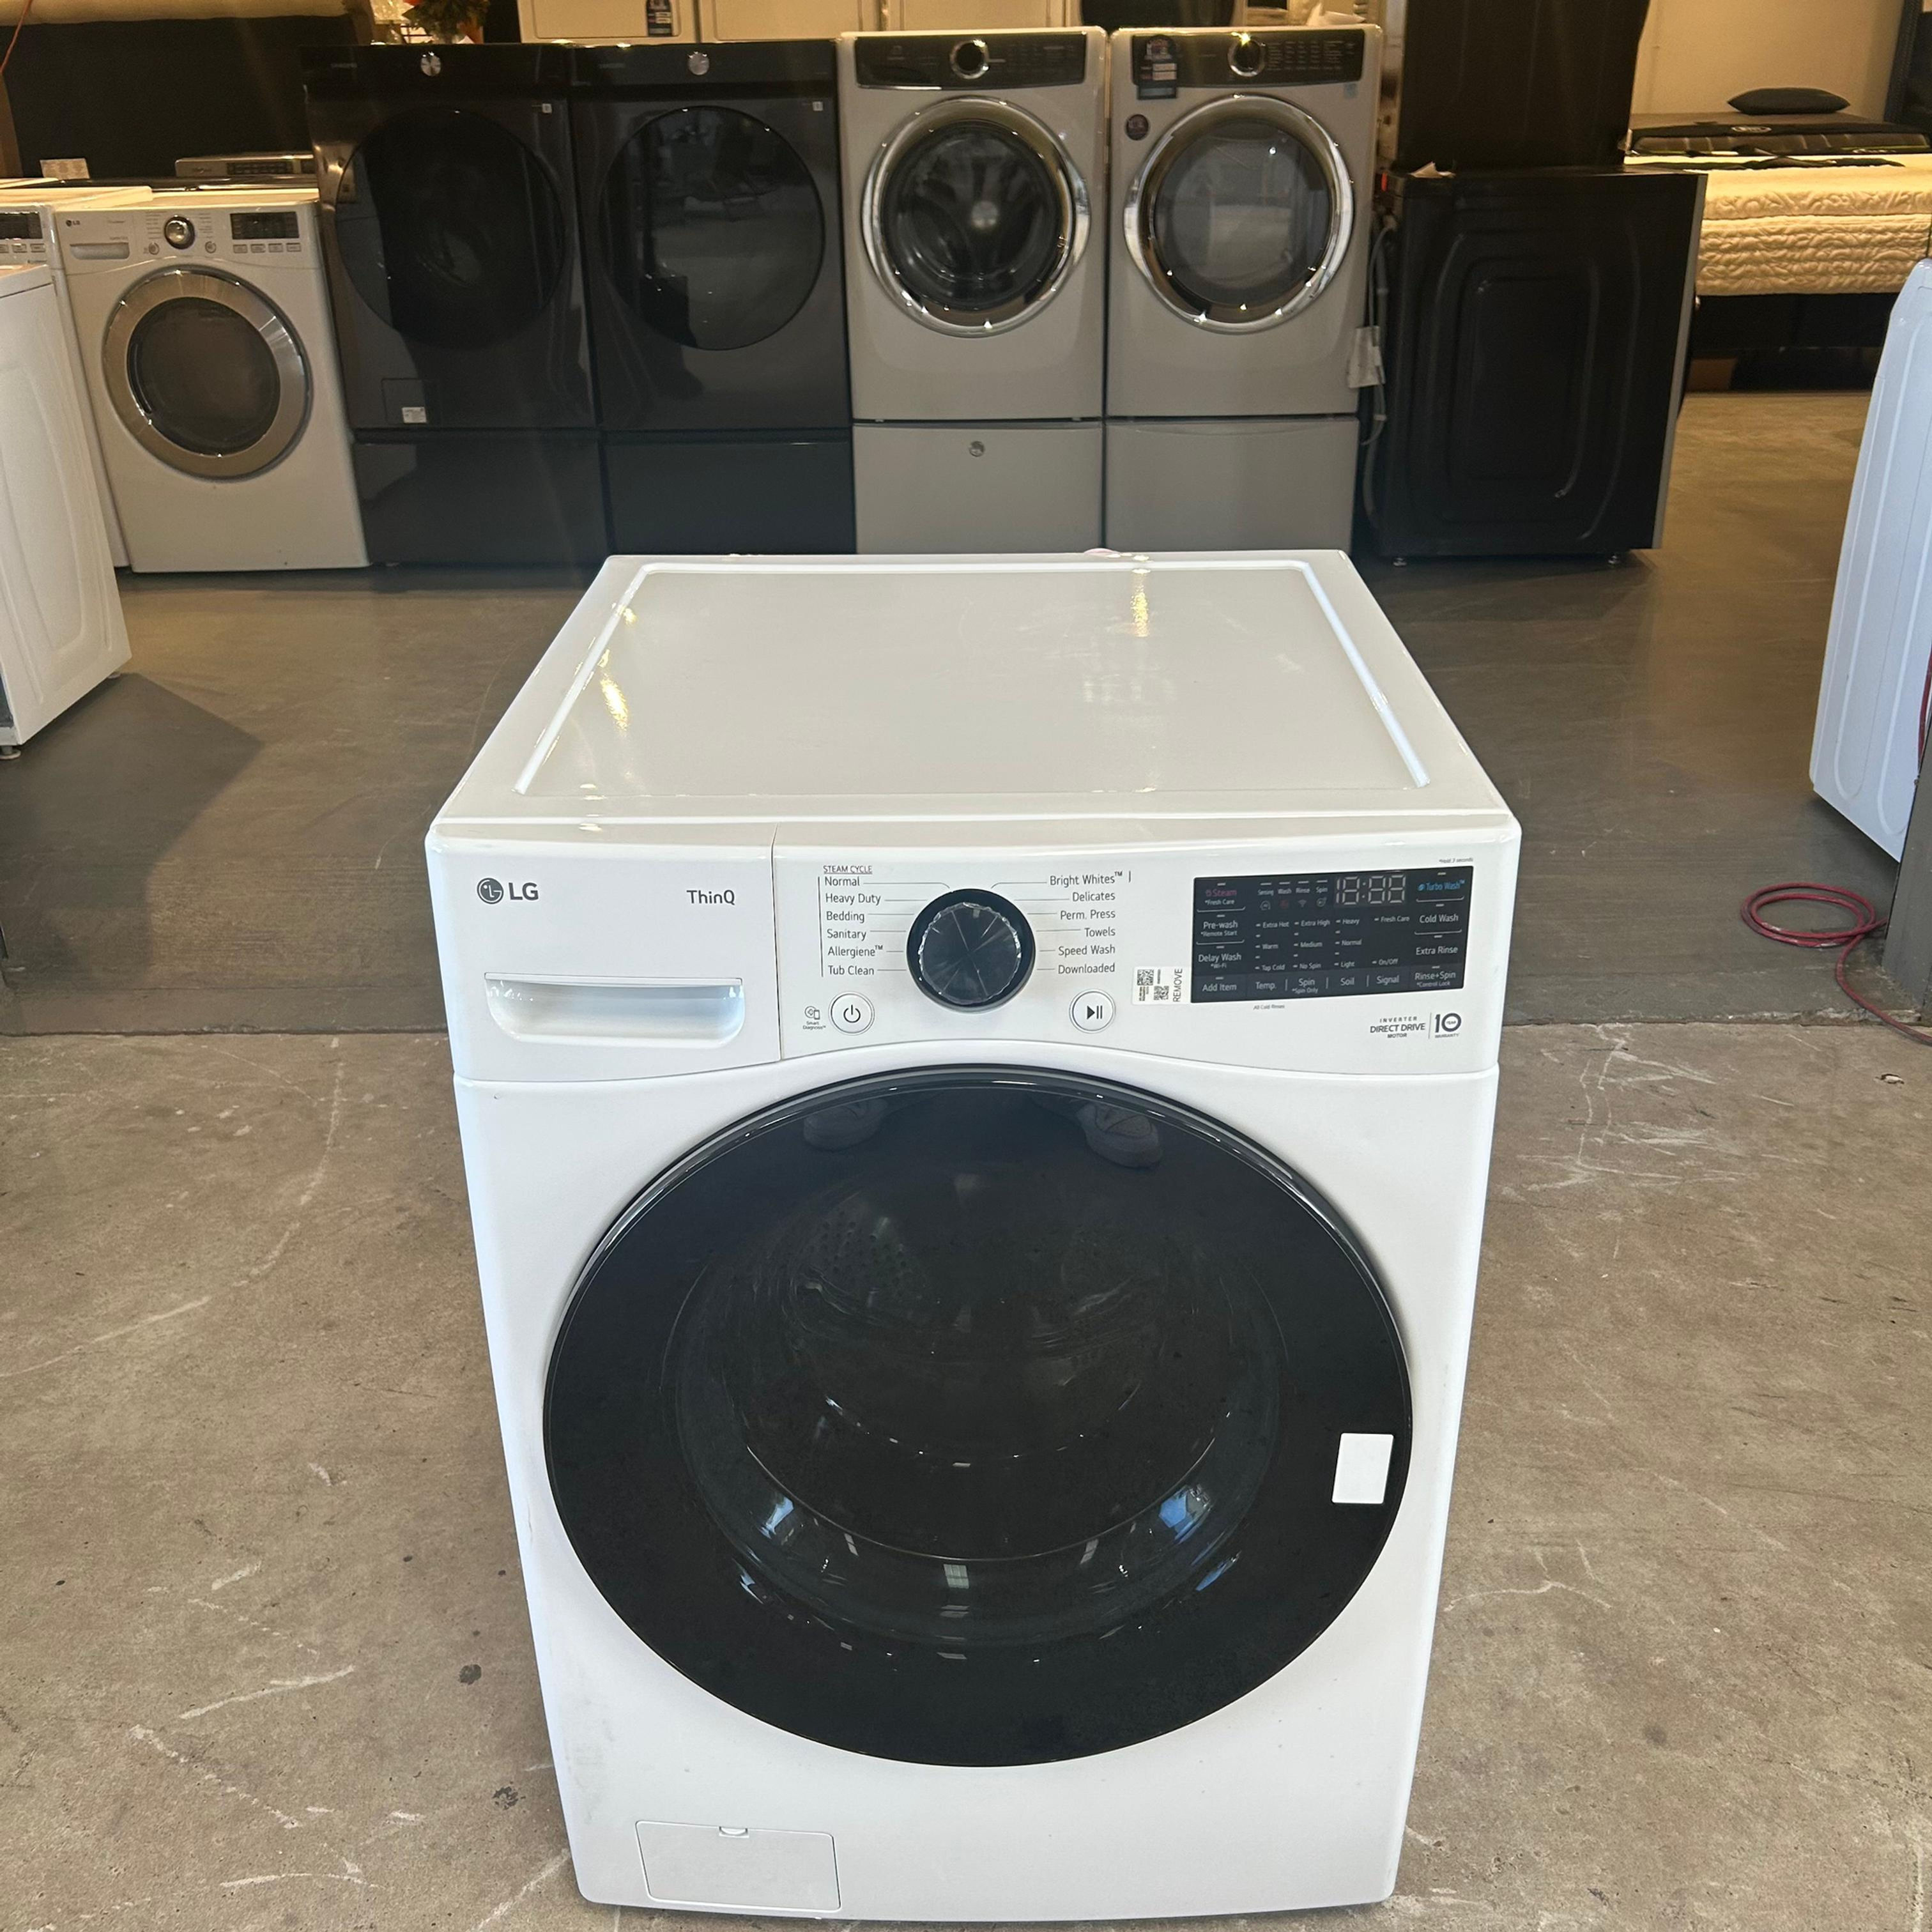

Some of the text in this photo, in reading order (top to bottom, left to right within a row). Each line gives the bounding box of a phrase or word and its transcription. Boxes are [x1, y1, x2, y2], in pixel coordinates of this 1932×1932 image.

[850, 866, 873, 874] CYCLE
[824, 876, 861, 887] Normal
[1050, 875, 1080, 888] Bright
[1425, 882, 1443, 891] Turbo
[509, 882, 539, 901] LG
[1072, 891, 1116, 902] Delicates
[1213, 889, 1238, 897] Steam
[686, 889, 735, 906] ThinQ
[825, 893, 882, 906] Heavy Duty
[826, 910, 865, 924] Bedding
[1060, 908, 1116, 921] Perm. Press
[1419, 913, 1459, 924] Cold Wash
[1203, 920, 1238, 930] Pre-wash
[1317, 919, 1331, 928] High
[827, 928, 867, 942] Sanitary
[1084, 926, 1116, 937] Towels
[1058, 944, 1116, 958] Speed Wash
[1416, 945, 1459, 956] Extra Rinse
[1198, 953, 1242, 963] Delay Wash
[1378, 958, 1399, 966] On/Off
[1058, 963, 1116, 974] Downloaded
[1309, 962, 1321, 970] Spin
[1340, 960, 1355, 969] Light
[828, 965, 875, 976] Tub Clean
[1414, 970, 1457, 981] Rinse+Spin
[1172, 968, 1183, 1002] REMOVE
[1298, 977, 1316, 988] Spin
[1340, 977, 1355, 986] Soil
[1376, 974, 1400, 986] Signal
[1202, 983, 1238, 992] Add Item
[1255, 981, 1277, 992] Temp.
[1370, 1022, 1426, 1034] DIRECT DRIVE
[1434, 1012, 1462, 1034] 10
